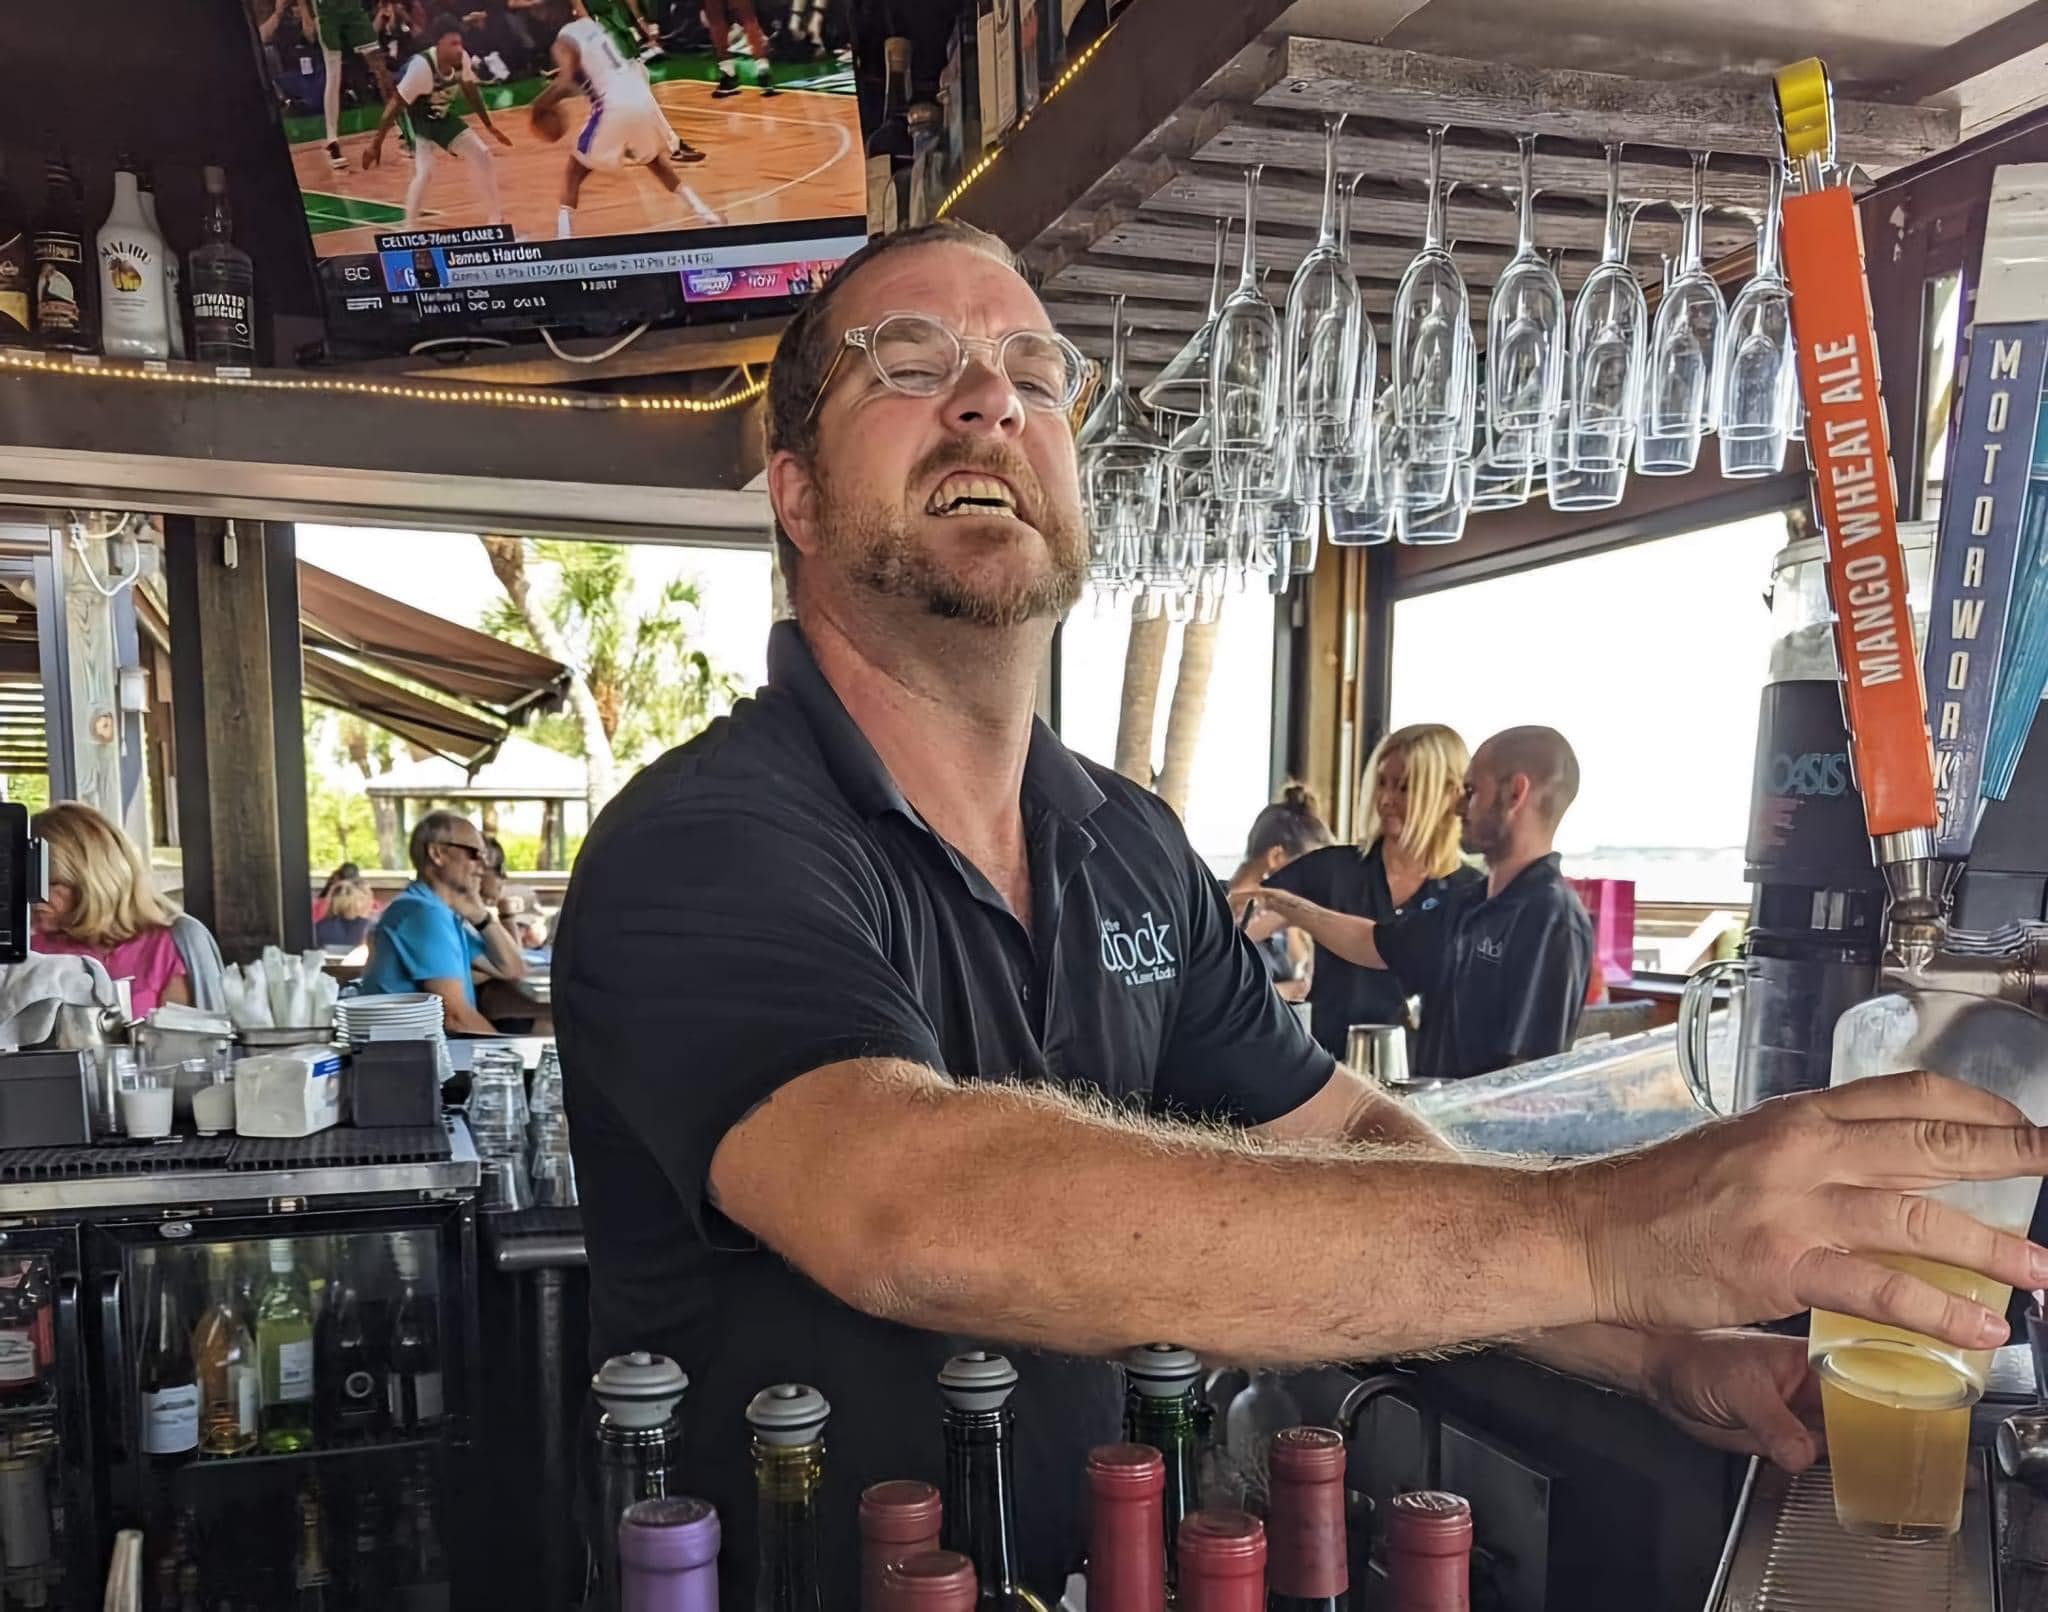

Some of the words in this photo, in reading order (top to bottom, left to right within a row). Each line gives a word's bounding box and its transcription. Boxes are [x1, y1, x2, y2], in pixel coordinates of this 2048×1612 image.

[447, 249, 491, 266] James
[492, 246, 541, 262] Harden
[463, 229, 494, 242] GAME
[344, 267, 370, 280] SC
[1813, 333, 1865, 404] ALE
[1824, 418, 1883, 548] WHEAT
[1845, 553, 1904, 688] MANGO
[1770, 753, 1847, 796] OASIS
[1101, 911, 1176, 972] dock
